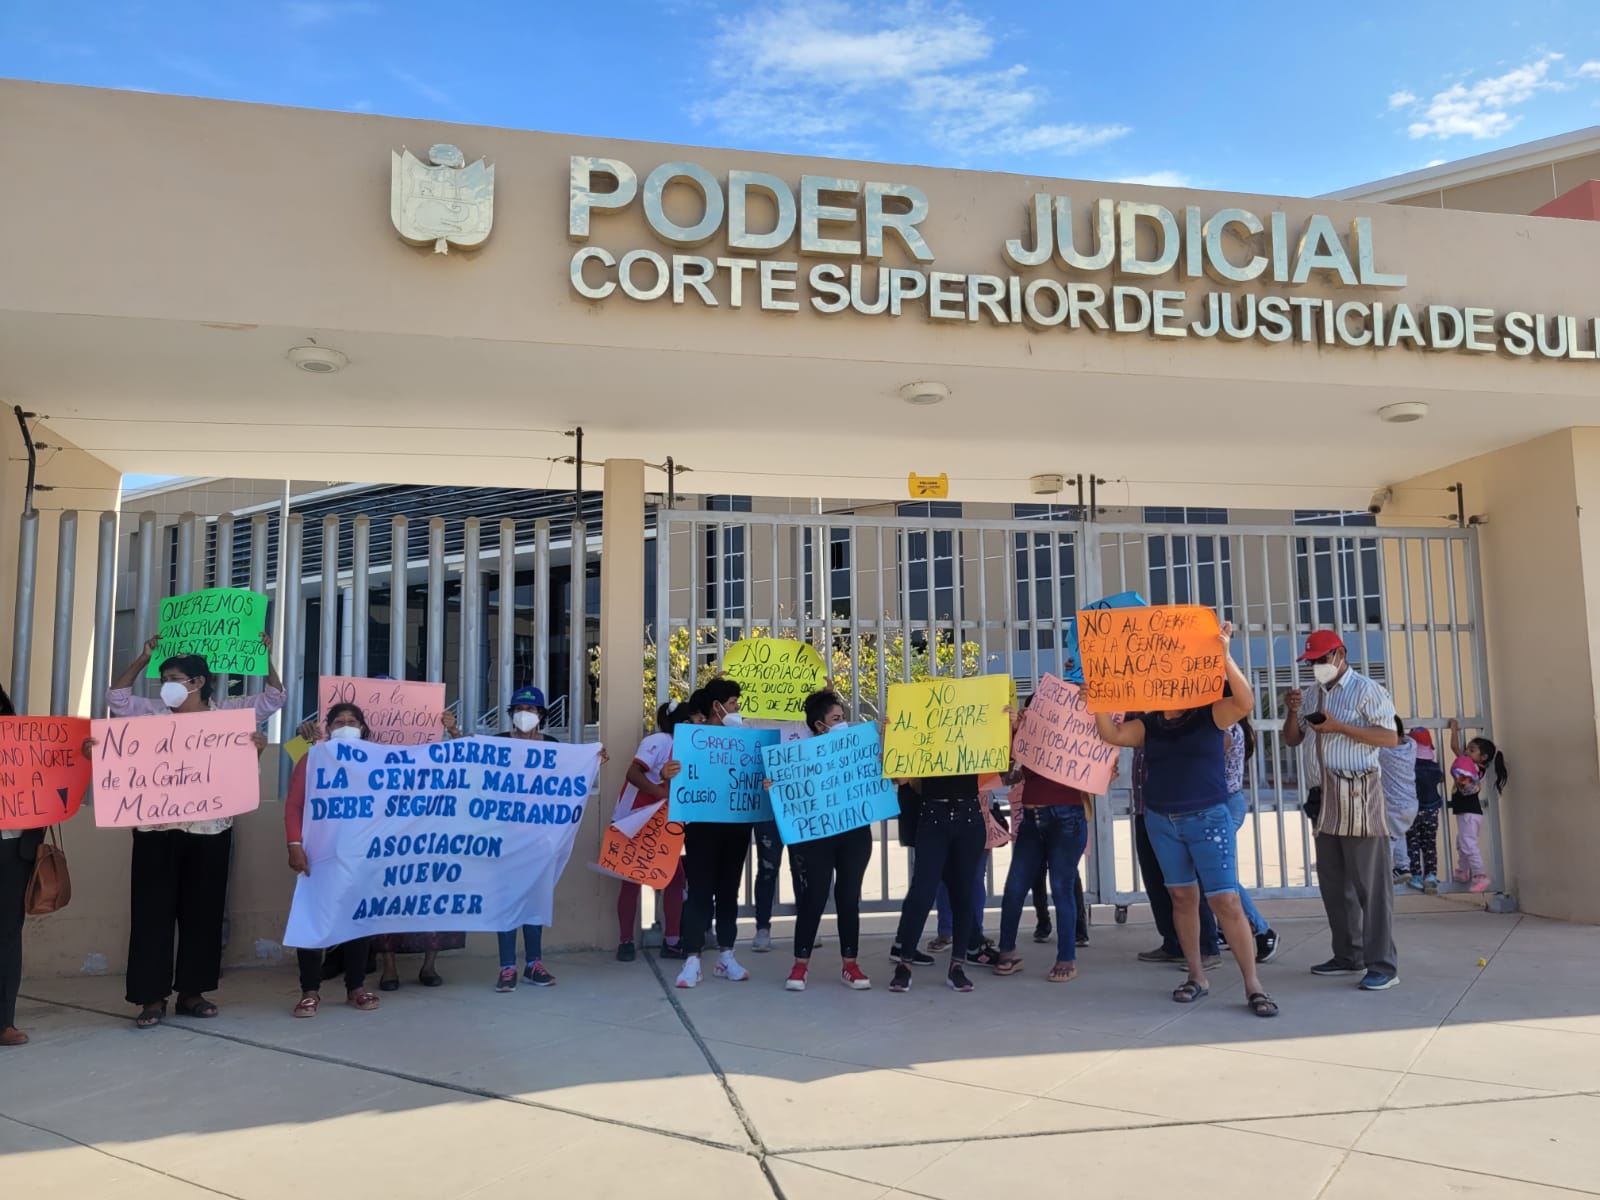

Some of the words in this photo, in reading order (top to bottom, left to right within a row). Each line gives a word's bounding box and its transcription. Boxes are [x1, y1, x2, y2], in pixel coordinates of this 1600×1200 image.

[569, 155, 934, 265] PODER
[1004, 192, 1408, 288] JUDICIAL
[569, 246, 800, 312] CORTE
[808, 263, 1109, 330] SUPERIOR
[1112, 285, 1188, 337] DE
[1190, 291, 1427, 347] JUSTICIA
[1429, 304, 1497, 352] DE
[162, 593, 254, 622] QUEREMOS
[1083, 609, 1113, 638] NO
[1121, 616, 1143, 634] AL
[1149, 608, 1200, 632] CIERRE
[155, 638, 222, 659] NUESTRO
[227, 637, 267, 656] PUESTO
[742, 639, 771, 664] NO
[780, 651, 790, 664] a
[794, 644, 809, 665] la
[1080, 639, 1095, 655] DE
[1103, 637, 1119, 652] LA
[208, 653, 256, 673] ABAJO
[1087, 653, 1173, 679] MALACAS
[1181, 653, 1223, 674] DEBE
[328, 679, 356, 704] NO
[740, 681, 757, 693] DEL
[761, 681, 795, 694] DUCTO
[800, 682, 816, 694] DE
[925, 682, 956, 708] NO
[1088, 678, 1136, 699] SEGUIR
[1143, 675, 1223, 699] OPERANDO
[766, 699, 781, 710] DE
[893, 710, 919, 731] AL
[926, 703, 990, 730] CIERRE
[1, 720, 69, 744] PUEBLOS
[101, 721, 141, 761] No
[154, 720, 177, 754] al
[184, 728, 250, 750] cierre
[691, 728, 746, 753] GRACIAS
[816, 744, 826, 757] ES
[831, 733, 860, 755] DUEÑO
[913, 731, 936, 746] DE
[945, 727, 964, 744] LA
[29, 742, 75, 768] NORTE
[336, 742, 368, 763] NO
[384, 750, 416, 765] AL
[428, 741, 512, 768] CIERRE
[523, 748, 557, 769] DE
[709, 751, 737, 766] ENEL
[839, 755, 850, 769] SU
[853, 742, 880, 762] DUCTO
[883, 747, 953, 775] CENTRAL
[956, 743, 1009, 773] MALACAS
[1041, 727, 1114, 765] POBLACIÓN
[688, 763, 700, 781] EL
[1015, 738, 1030, 757] DE
[1032, 746, 1092, 784] TALARA
[31, 770, 44, 788] A
[101, 768, 121, 791] de
[128, 766, 147, 789] la
[316, 767, 349, 790] LA
[368, 767, 471, 791] CENTRAL
[482, 770, 587, 798] MALACAS
[728, 767, 764, 790] SANTA
[773, 779, 816, 803] TODO
[857, 764, 882, 781] REGL
[0, 789, 49, 821] NEL
[113, 793, 224, 824] Malacas
[310, 795, 374, 821] DEBE
[384, 794, 457, 818] SEGUIR
[468, 797, 582, 826] OPERANDO
[729, 791, 761, 812] ELENA
[783, 798, 819, 818] ANTE
[826, 793, 841, 808] EL
[847, 778, 890, 801] ESTADO
[791, 800, 874, 840] PERUANO
[366, 832, 503, 859] ASOCIACION
[383, 862, 463, 888] NUEVO
[352, 893, 484, 921] AMANECER
